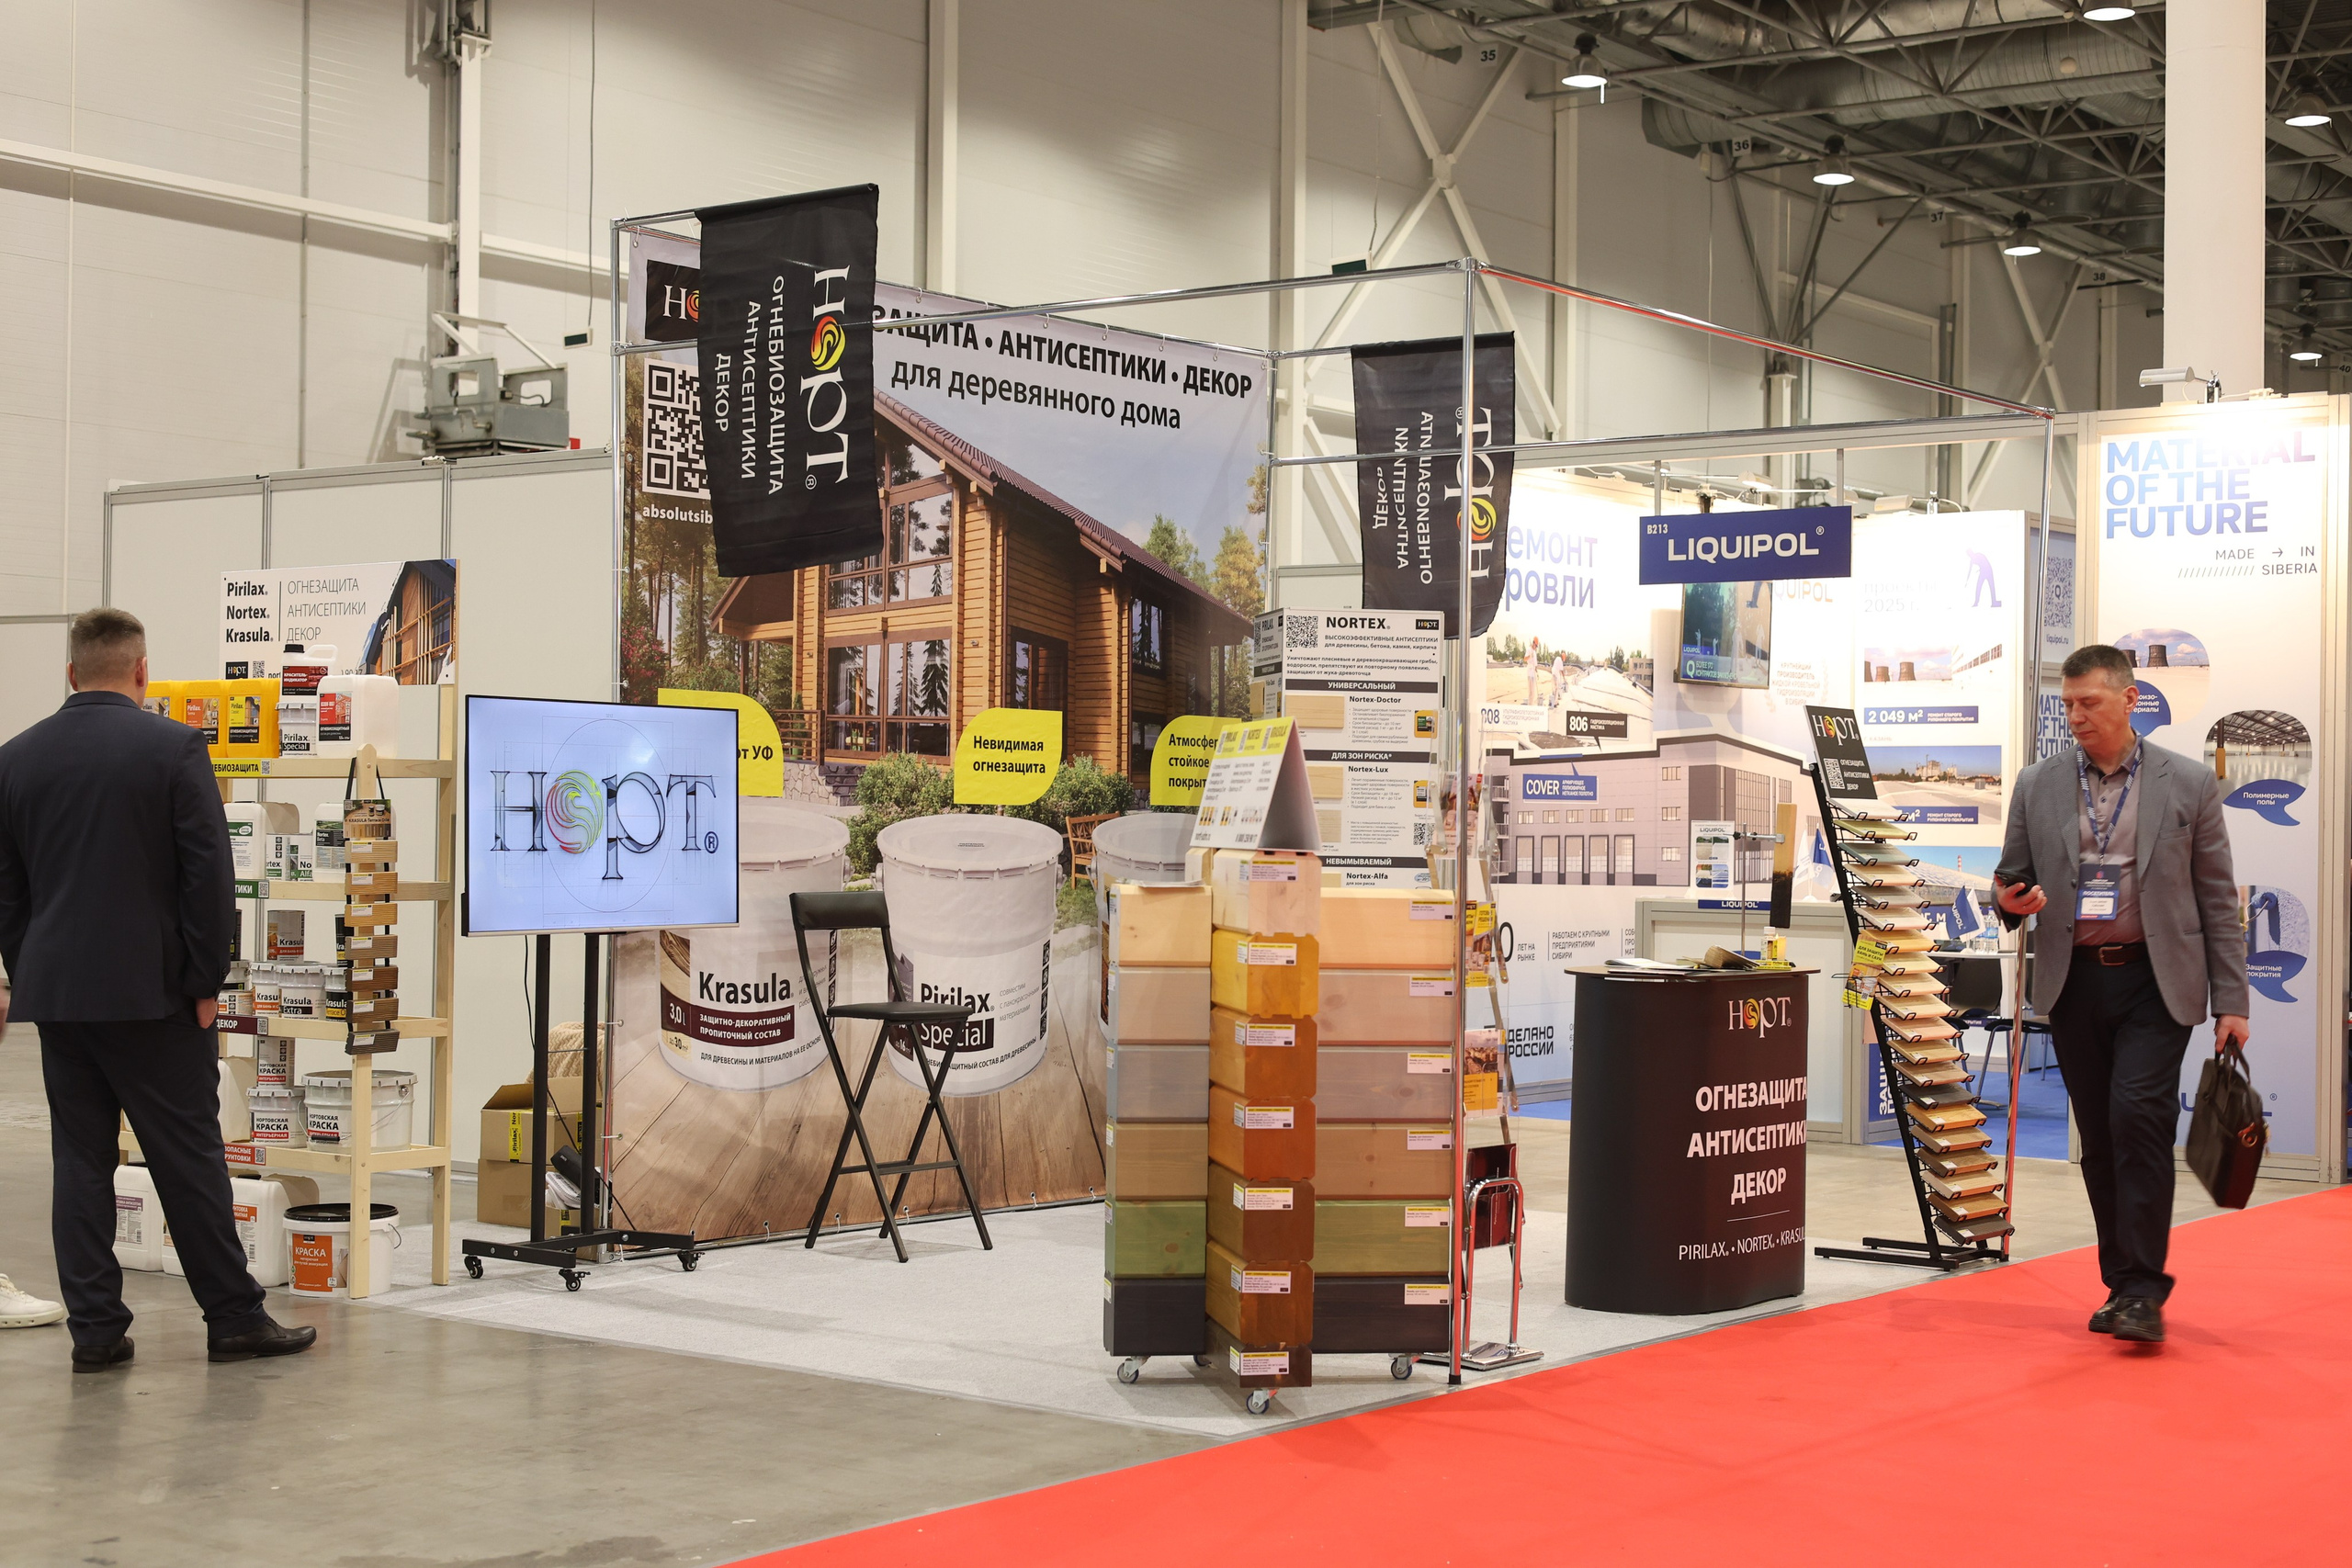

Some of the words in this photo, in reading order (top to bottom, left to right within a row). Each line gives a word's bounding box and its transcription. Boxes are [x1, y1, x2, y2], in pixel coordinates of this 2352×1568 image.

[1480, 50, 1497, 62] 35
[1734, 140, 1750, 152] 36
[999, 330, 1167, 386] АНТИСЕПТИКИ
[1182, 364, 1252, 399] ДЕКОР
[741, 300, 761, 479] АНТИСЕПТИКИ
[768, 276, 785, 495] ОГНЕБИОЗАЩИТА
[715, 353, 731, 433] ДЕКОР
[891, 361, 942, 390] для
[948, 370, 1115, 419] деревянного
[1121, 399, 1181, 429] дома
[2107, 431, 2315, 474] MATERIAL
[2106, 473, 2159, 506] OF
[2168, 468, 2250, 503] THE
[2107, 501, 2268, 539] FUTURE
[1646, 524, 1668, 535] B213
[1508, 525, 1598, 568] емонт
[2215, 548, 2255, 560] MADE
[2301, 546, 2315, 557] IN
[2261, 563, 2318, 576] SIBERIA
[288, 578, 359, 594] ОГНЕЗАЩИТА
[1505, 567, 1594, 612] ровли
[287, 602, 366, 617] АНТИСЕПТИКИ
[287, 627, 322, 643] ДЕКОР
[1328, 681, 1396, 690] УНИВЕРСАЛЬНЫЙ
[1349, 695, 1402, 704] Nortex-Doctor
[1569, 716, 1588, 732] 806
[974, 735, 1044, 753] Невидимая
[752, 745, 774, 761] УФ
[1331, 752, 1346, 761] ДЛЯ
[973, 759, 1046, 776] огнезащита
[1169, 755, 1210, 768] стойкое
[1840, 759, 1865, 768] ОГНЕЗАЩИТА
[1844, 771, 1871, 779] АНТИСЕПТИКИ
[1169, 777, 1206, 790] покрыт
[1526, 779, 1560, 795] COVER
[1847, 783, 1859, 791] ДЕКОР
[2243, 791, 2290, 800] Полимерные
[1552, 931, 1577, 939] РАБОТАЕМ
[1582, 930, 1611, 938] КРУПНЫМИ
[1552, 941, 1596, 950] ПРЕДПРИЯТИЯМИ
[1517, 953, 1536, 962] РЫНКЕ
[1552, 952, 1573, 960] СИБИРИ
[2245, 964, 2283, 973] Защитные
[2246, 971, 2281, 979] покрытия
[699, 1011, 791, 1028] ЗАЩИТНО-ДЕКОРАТИВНЫЙ
[700, 1026, 752, 1040] ПРОПИТОЧНЫЙ
[754, 1028, 781, 1039] СОСТАВ
[1508, 1025, 1554, 1043] ДЕЛАНО
[673, 1036, 682, 1050] 30
[700, 1052, 712, 1060] ДЛЯ
[713, 1055, 748, 1066] ДРЕВЕСИНЫ
[754, 1051, 793, 1065] МАТЕРИАЛОВ
[806, 1035, 821, 1051] ОСНОВЕ
[978, 1059, 1000, 1068] СОСТАВ
[1000, 1053, 1011, 1063] ДЛЯ
[1011, 1037, 1037, 1058] ДРЕВЕСИНЫ
[256, 1122, 288, 1131] КРАСКА
[309, 1121, 339, 1131] КРАСКА
[1730, 1167, 1787, 1205] ДЕКОР
[295, 1247, 327, 1258] КРАСКА
